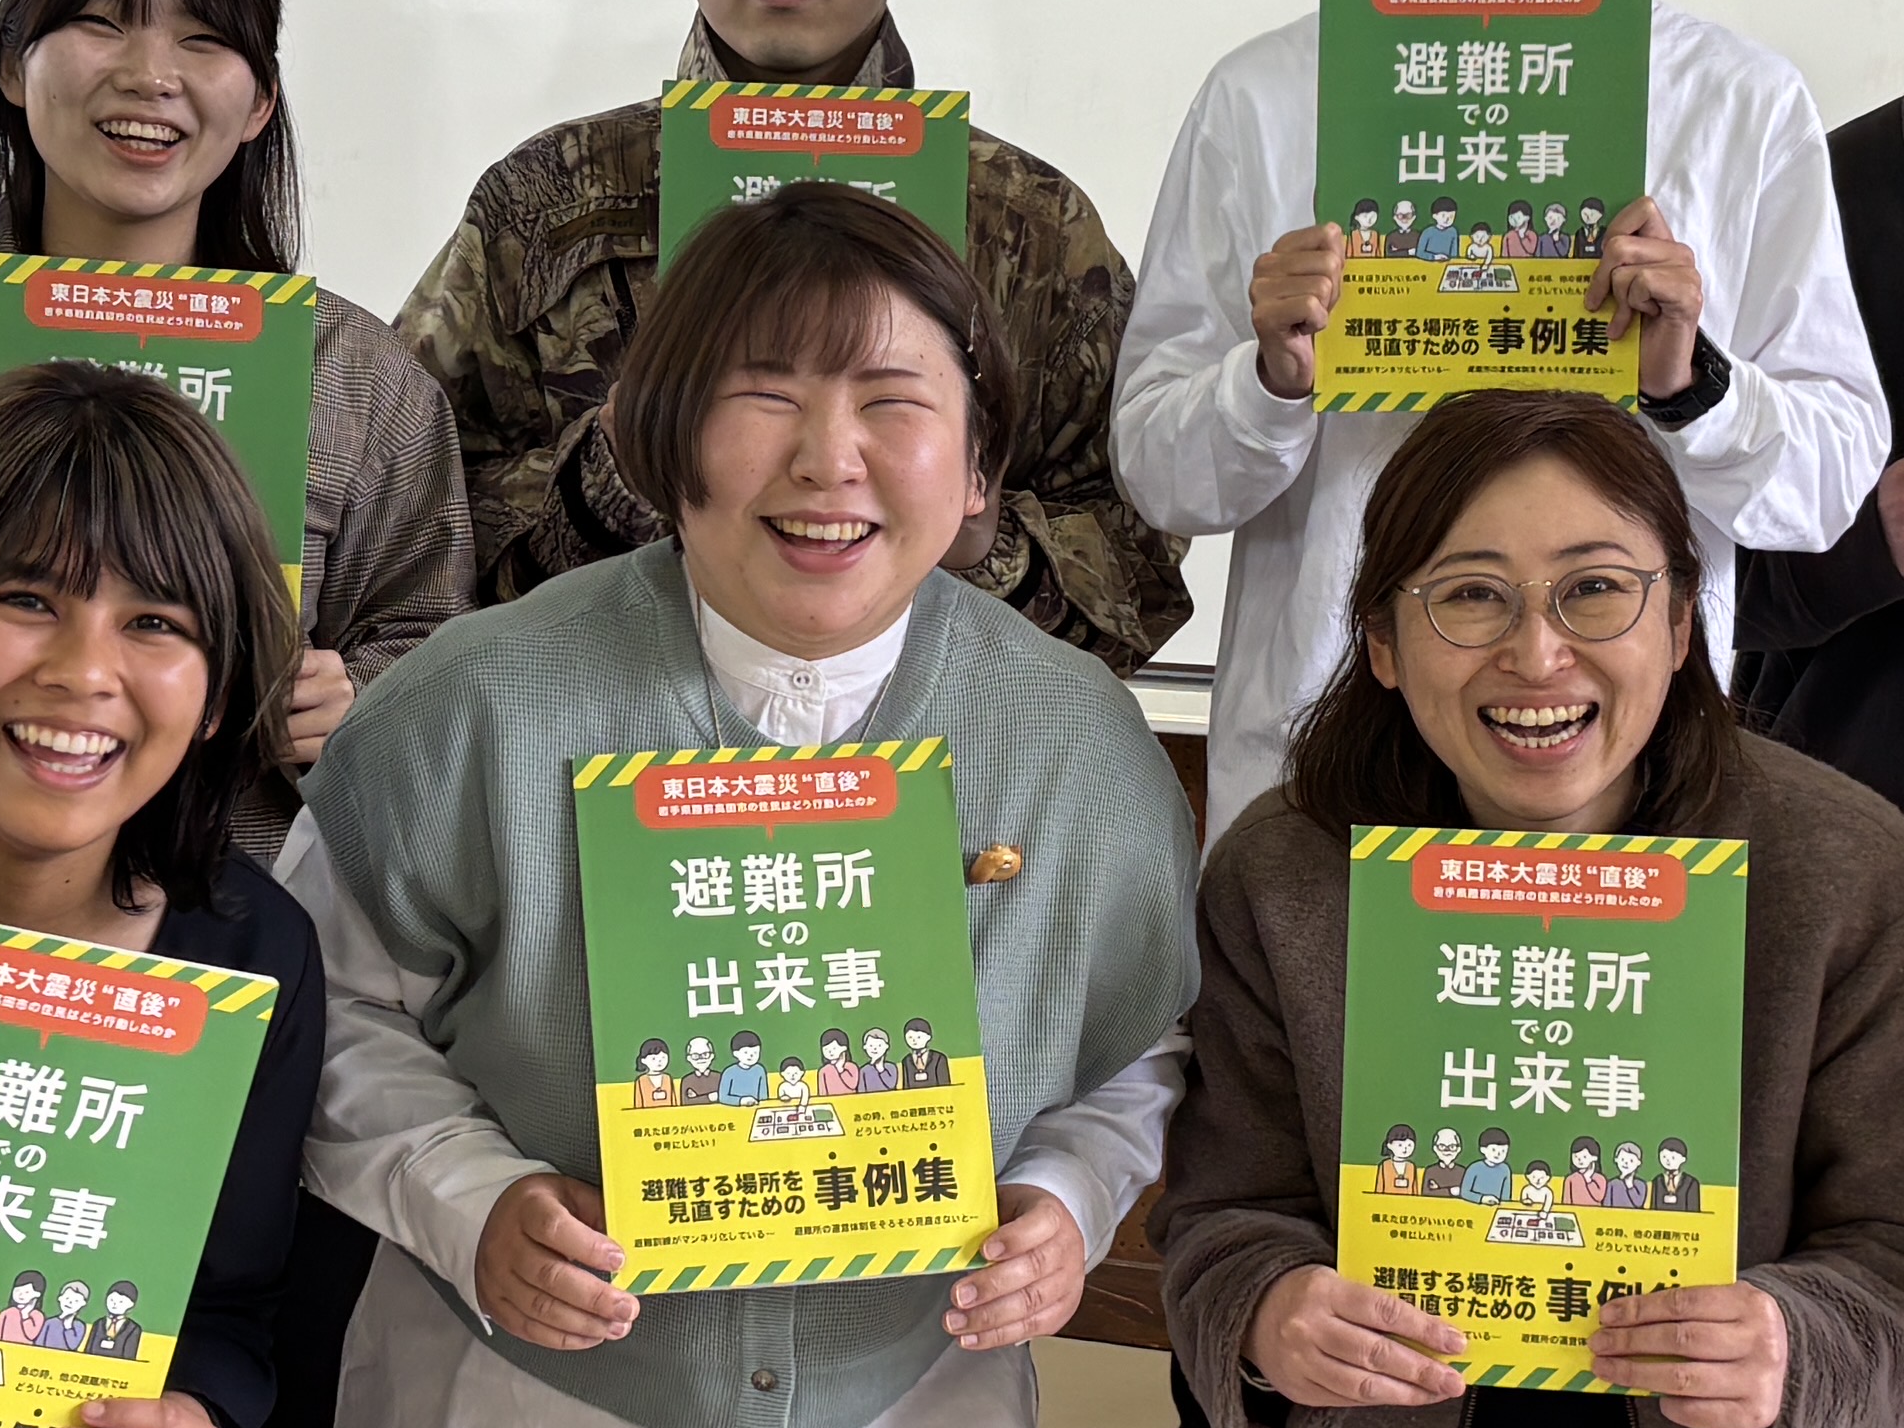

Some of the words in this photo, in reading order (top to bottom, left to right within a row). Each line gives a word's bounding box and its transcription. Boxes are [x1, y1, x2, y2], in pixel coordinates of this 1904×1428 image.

[1393, 41, 1574, 96] 避難所
[732, 107, 904, 131] 東日本大震災“直後”
[1457, 103, 1510, 126] での
[1398, 130, 1570, 184] 出来事
[50, 283, 241, 315] 東日本大震災“直後”
[1344, 317, 1480, 337] 避難する場所を
[1487, 316, 1610, 356] 事例集
[1364, 337, 1480, 357] 見直すための
[662, 770, 871, 800] 東日本大震災“直後”
[670, 848, 875, 918] 避難所
[1440, 859, 1660, 890] 東日本大震災“直後”
[748, 921, 809, 948] での
[687, 947, 885, 1018] 出来事
[1436, 943, 1651, 1015] 避難所
[1511, 1019, 1573, 1046] での
[1440, 1047, 1646, 1118] 出来事
[641, 1170, 803, 1202] 避難する場所を
[812, 1156, 959, 1211] 事例集
[668, 1194, 806, 1225] 見直すための
[1372, 1266, 1537, 1298] 避難する場所を
[1545, 1276, 1684, 1324] 事例
[15, 1380, 124, 1400] どうしていたんだ
